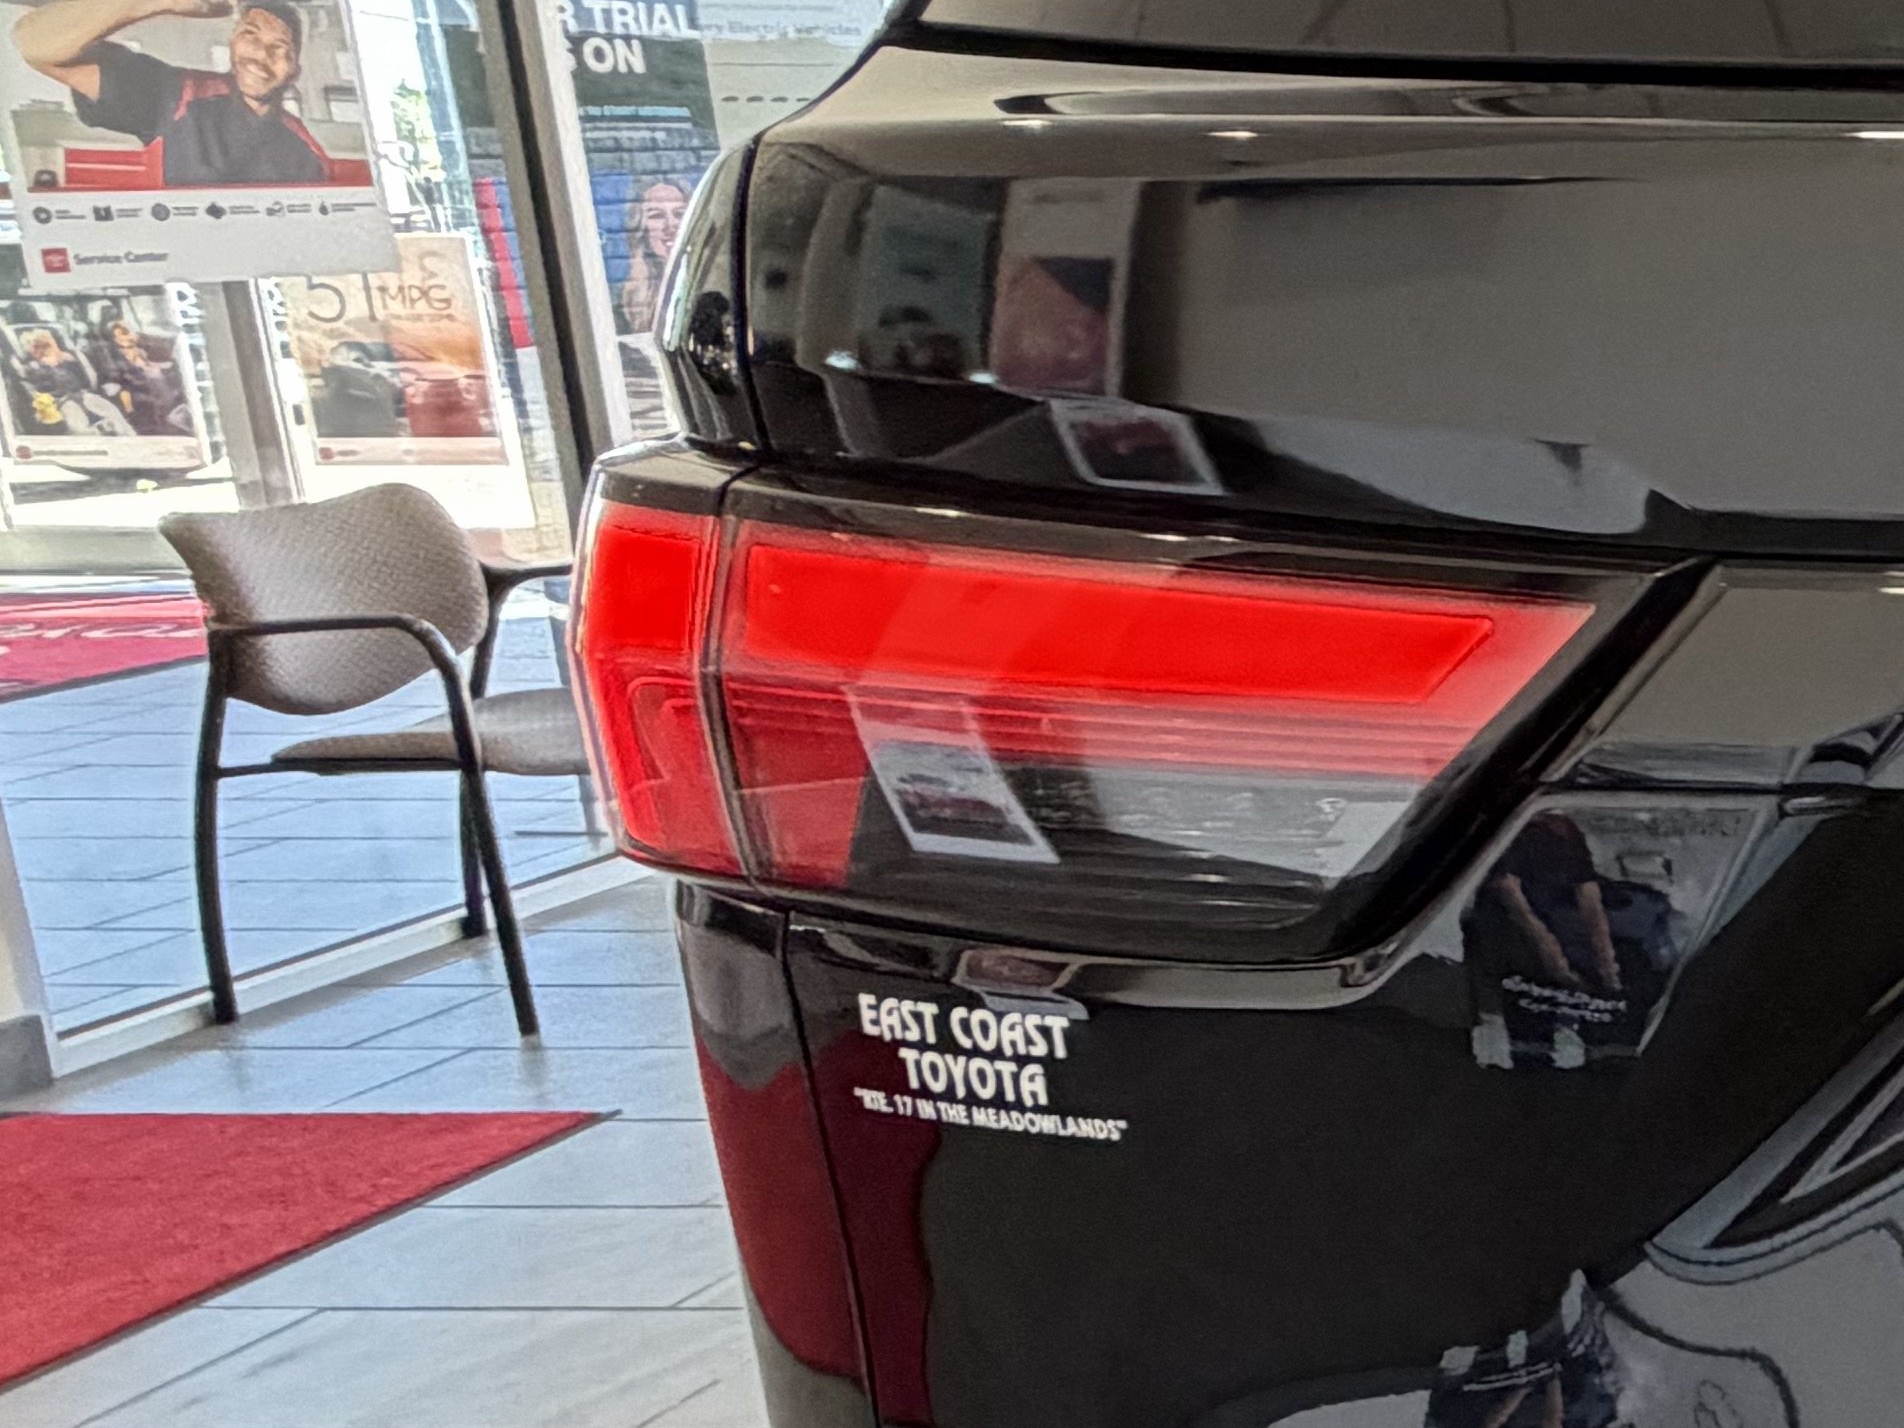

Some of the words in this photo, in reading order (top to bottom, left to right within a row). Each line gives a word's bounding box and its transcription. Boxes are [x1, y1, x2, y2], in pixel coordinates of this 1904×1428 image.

[582, 0, 701, 39] TRIAL
[583, 37, 646, 73] ON
[377, 283, 452, 312] MPG
[858, 992, 938, 1045] EAST
[949, 1005, 1070, 1059] COAST
[898, 1046, 1048, 1107] TOYOTA
[892, 1094, 912, 1116] 17
[915, 1097, 937, 1120] IN
[936, 1100, 970, 1125] THE
